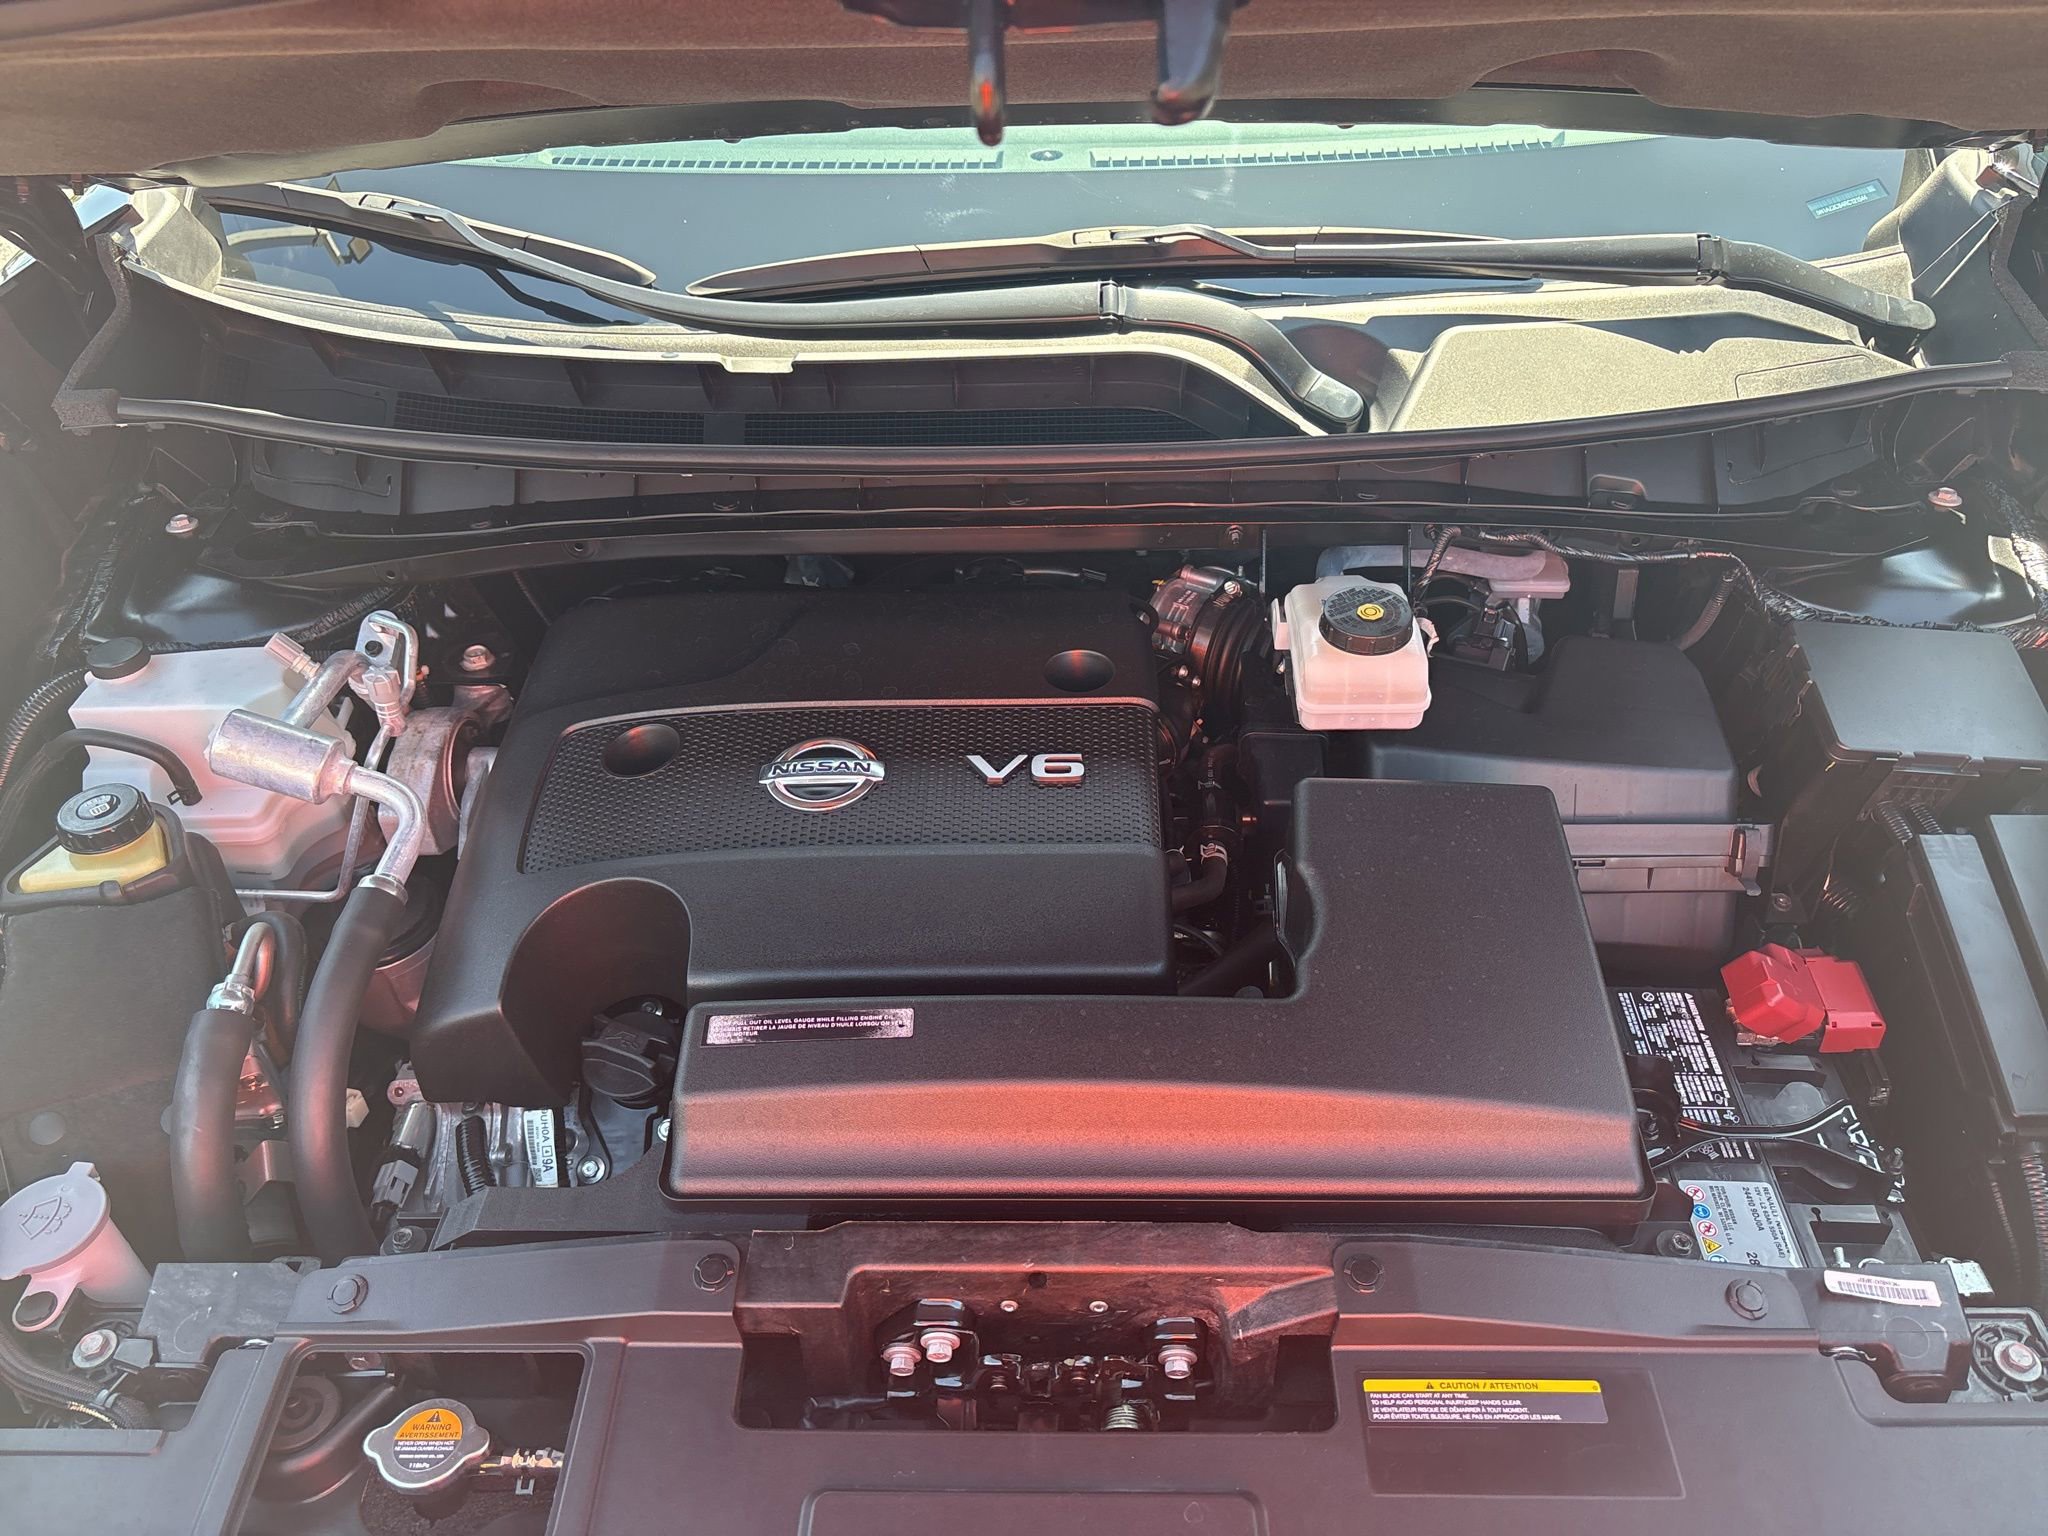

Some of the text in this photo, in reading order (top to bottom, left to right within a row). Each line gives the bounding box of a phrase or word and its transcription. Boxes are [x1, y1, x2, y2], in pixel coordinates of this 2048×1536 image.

[771, 760, 871, 775] NISSAN
[966, 753, 1086, 785] V6
[542, 1158, 554, 1173] 9A
[1742, 1186, 1756, 1207] 24410
[1440, 1382, 1480, 1390] CAUTION
[1490, 1382, 1538, 1390] ATTENTION
